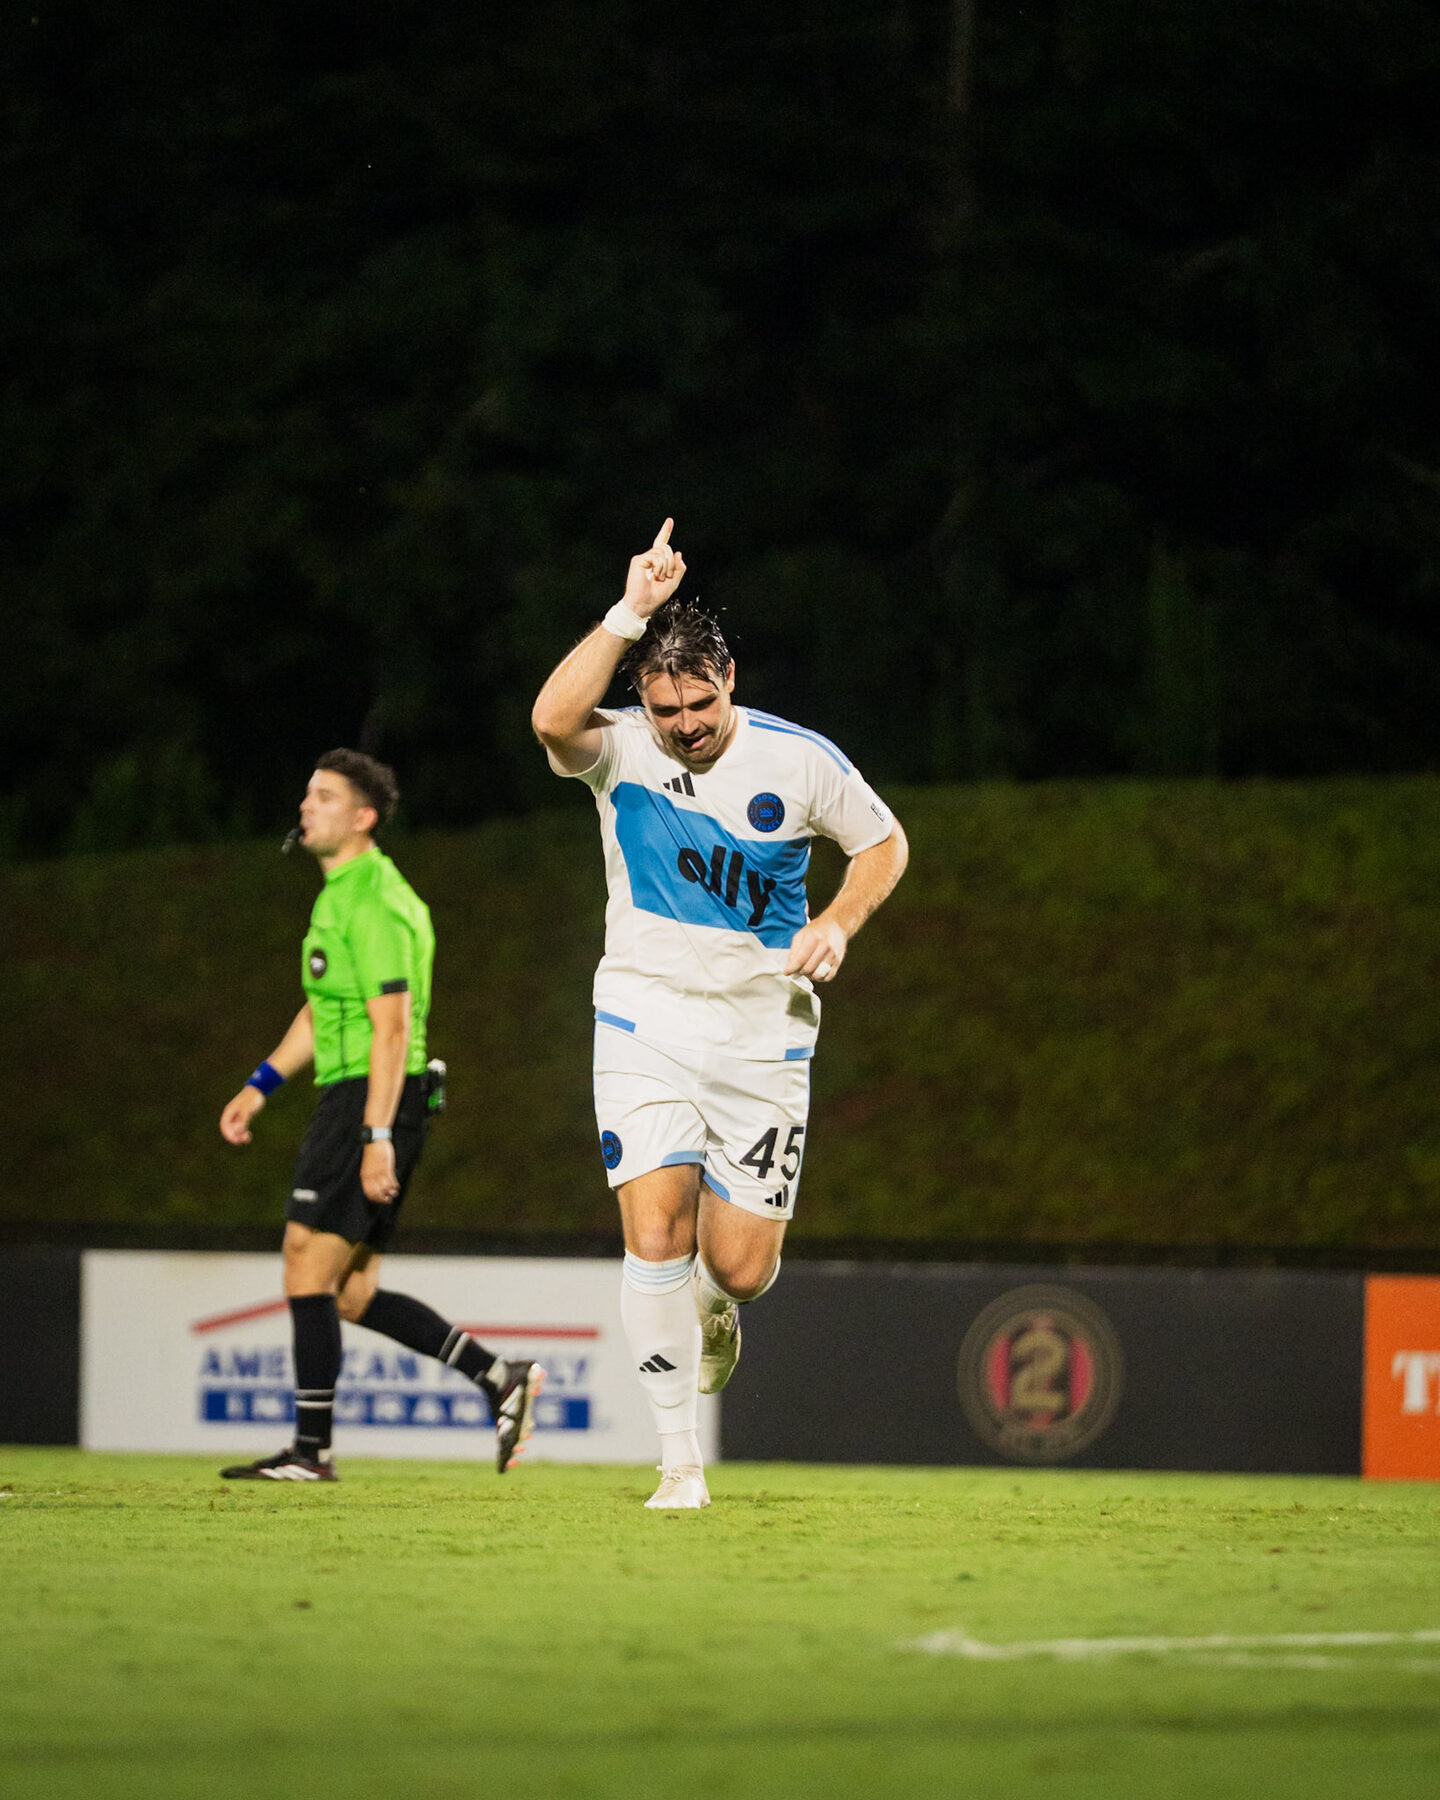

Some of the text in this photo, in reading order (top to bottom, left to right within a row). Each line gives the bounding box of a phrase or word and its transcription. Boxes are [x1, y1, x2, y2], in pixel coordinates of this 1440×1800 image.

[677, 845, 777, 926] ally
[739, 1126, 804, 1181] 45
[202, 1346, 419, 1380] AMECAN
[1012, 1328, 1068, 1412] 2
